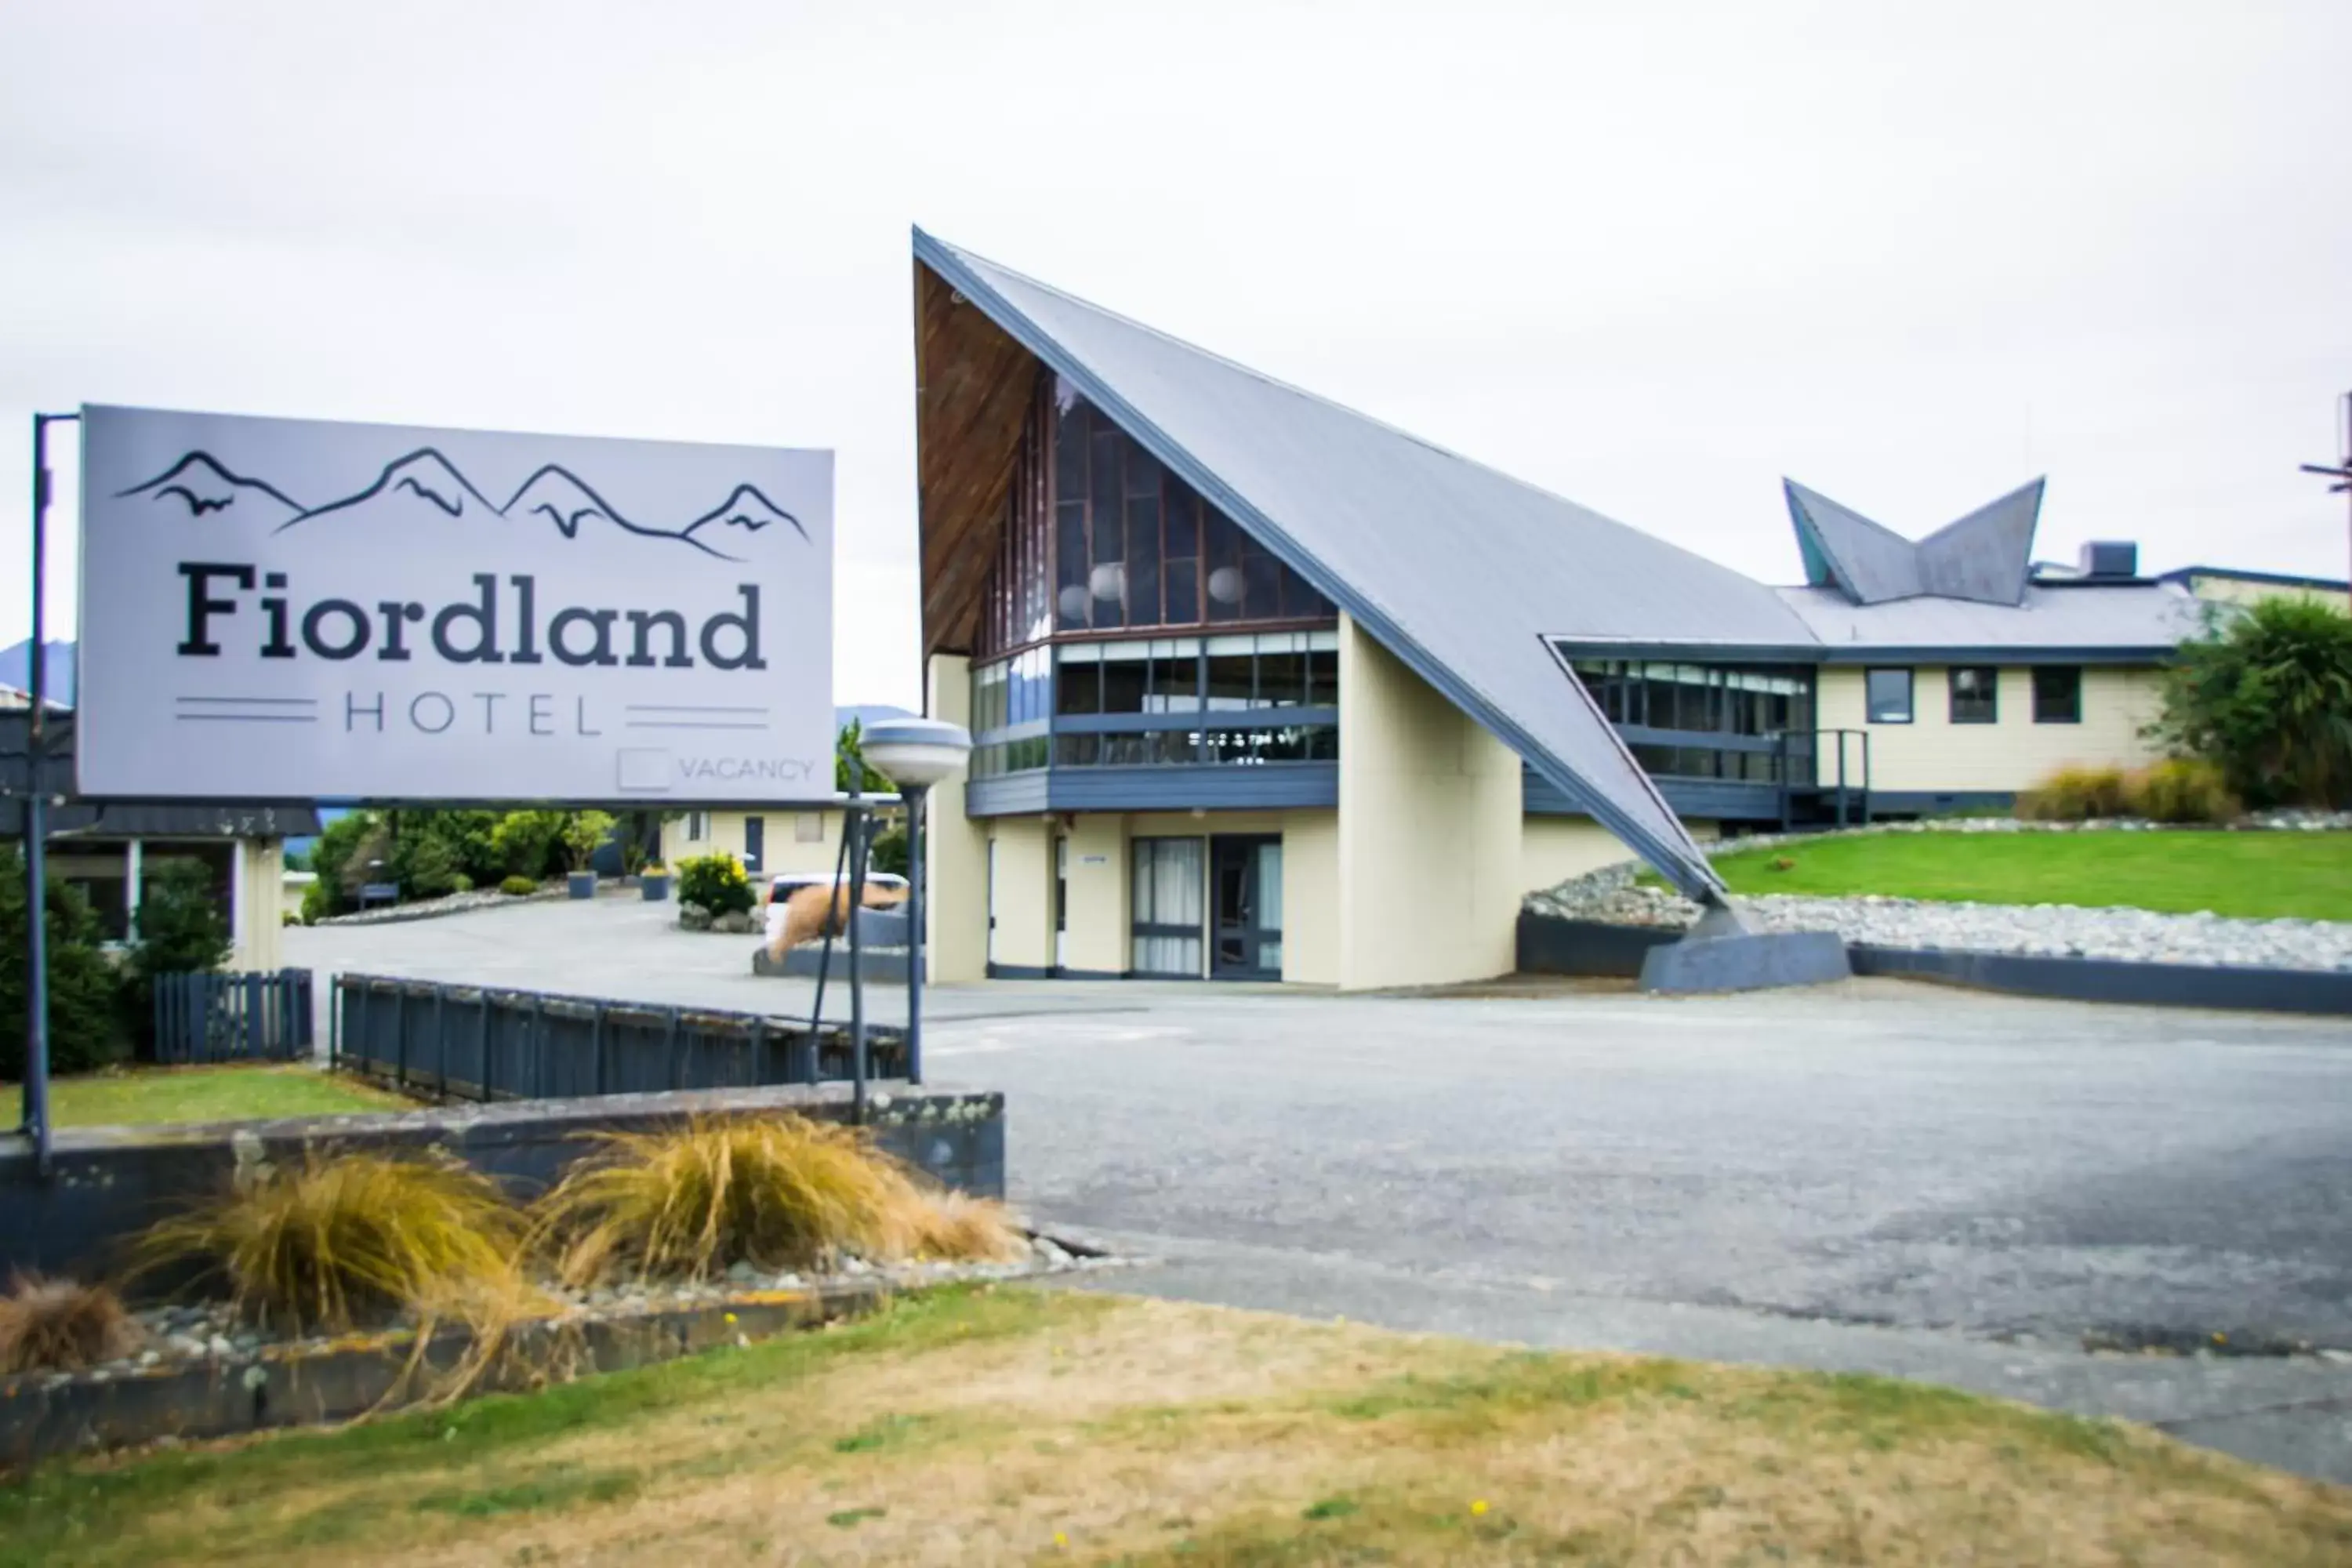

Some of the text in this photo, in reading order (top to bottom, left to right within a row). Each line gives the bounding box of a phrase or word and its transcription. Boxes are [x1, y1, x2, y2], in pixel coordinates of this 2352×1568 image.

[176, 561, 768, 671] Fiordland
[346, 690, 602, 736] HOTEL
[678, 757, 816, 781] VACANCY
